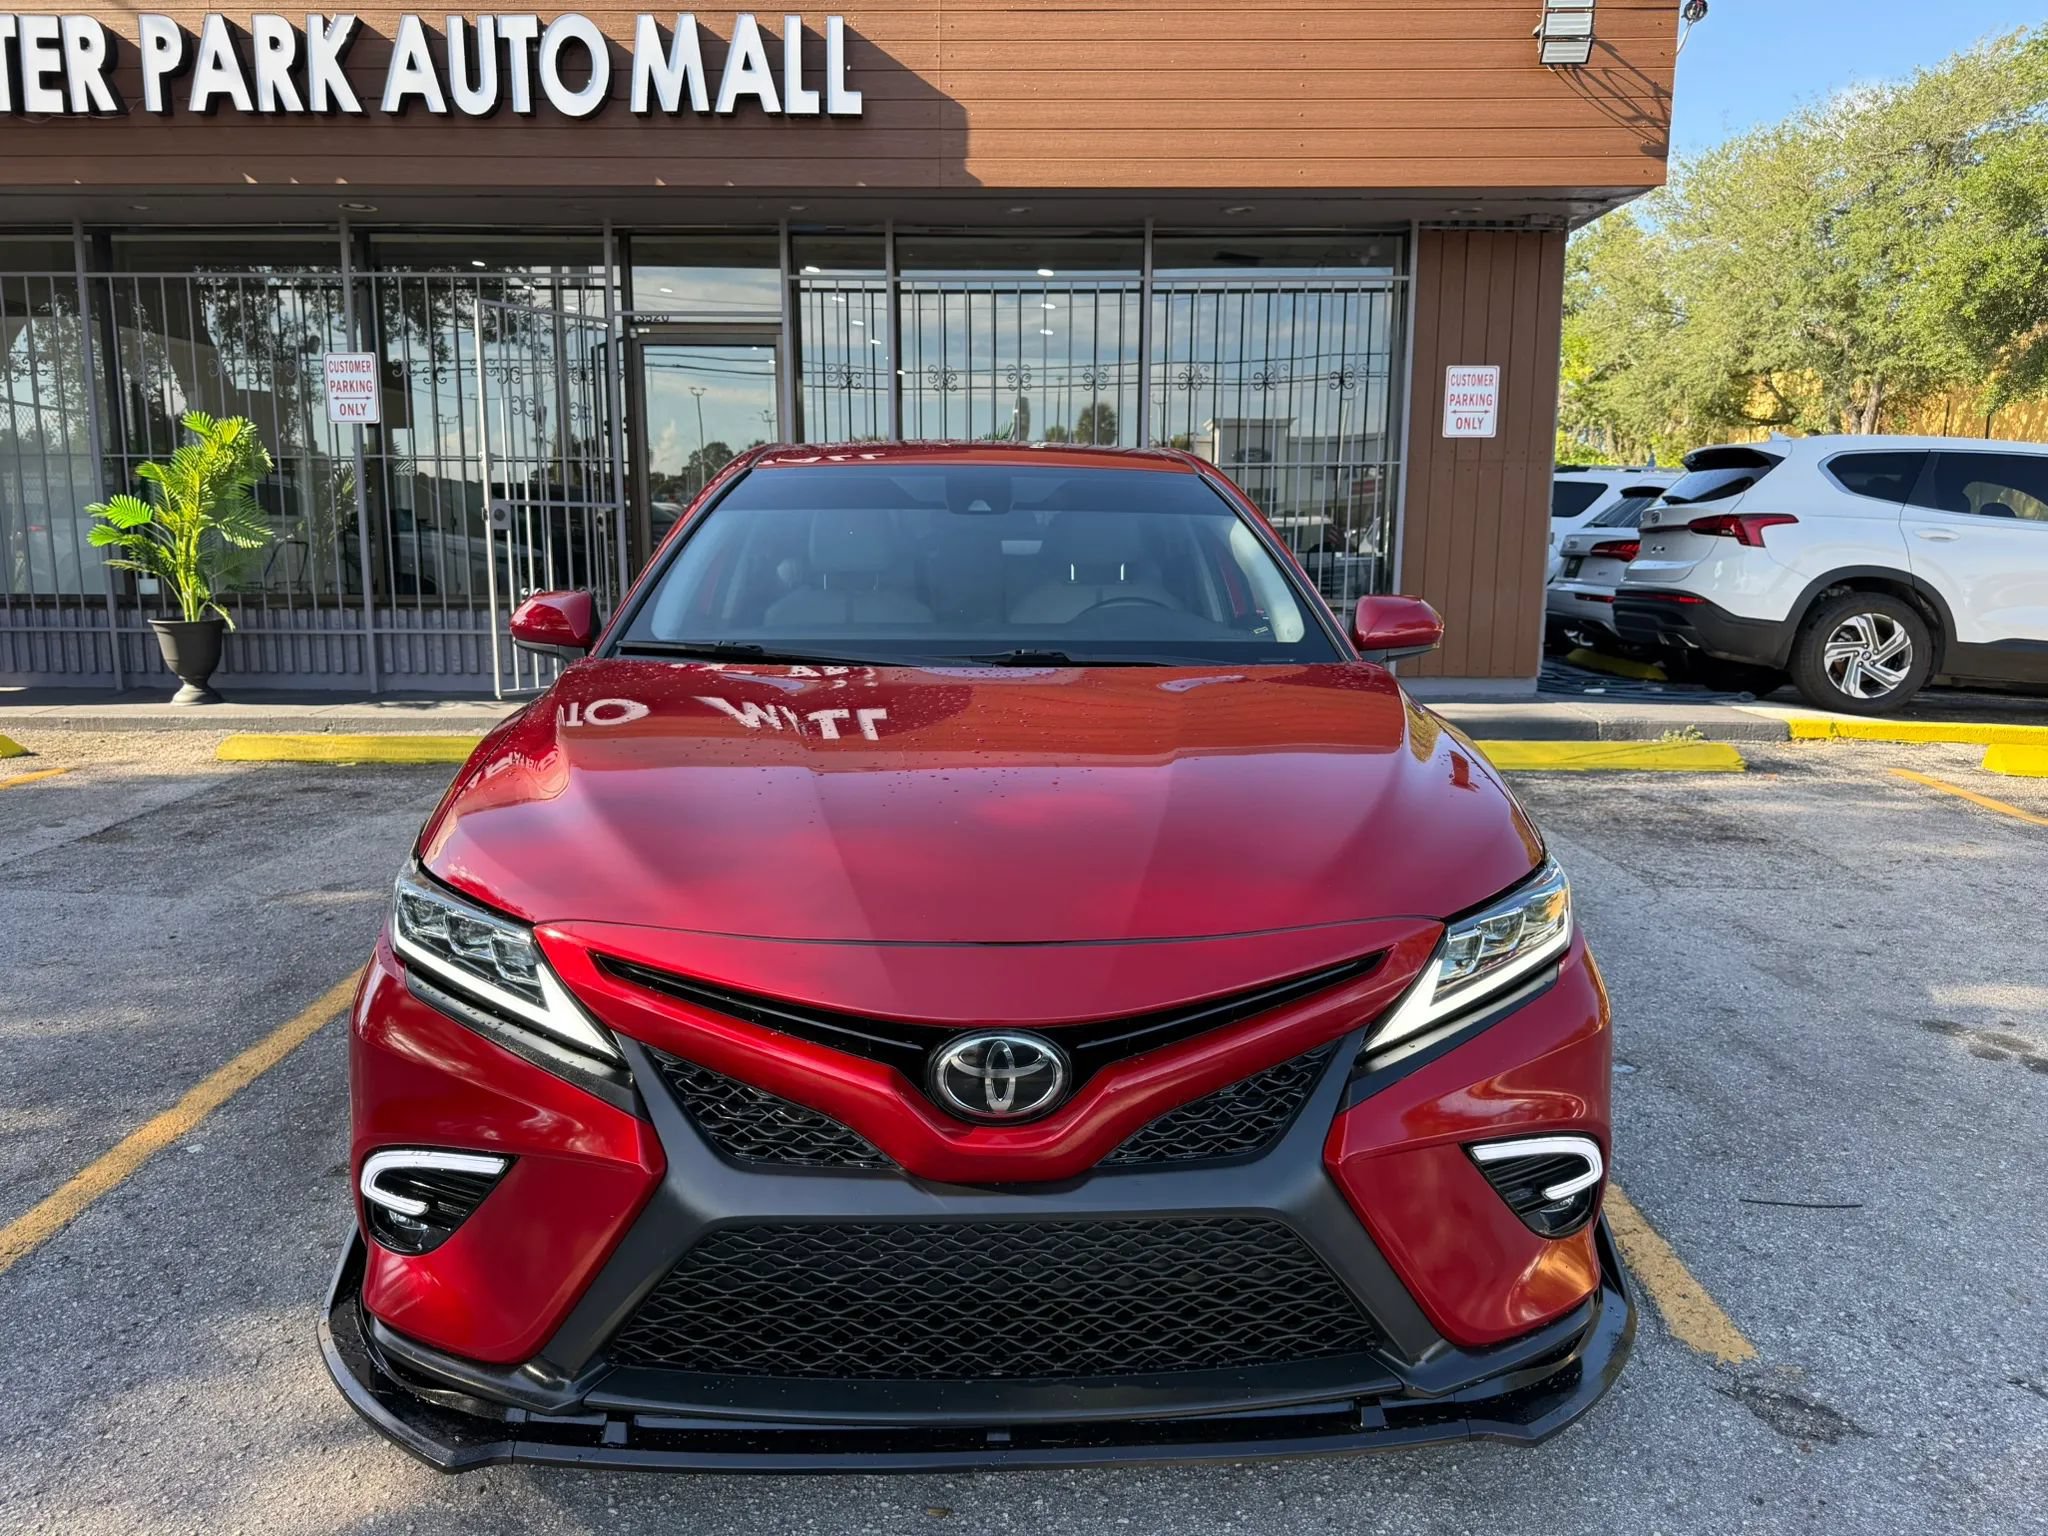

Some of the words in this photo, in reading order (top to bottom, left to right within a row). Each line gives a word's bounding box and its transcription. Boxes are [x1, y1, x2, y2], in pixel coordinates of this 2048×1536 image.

[138, 13, 364, 114] PARK
[382, 13, 611, 116] AUTO
[631, 13, 863, 115] MALL
[328, 360, 372, 373] CUSTOMER
[330, 380, 373, 392] PARKING
[1450, 373, 1494, 387] CUSTOMER
[1449, 393, 1493, 406] PARKING
[339, 403, 367, 416] ONLY
[1455, 417, 1484, 430] ONLY
